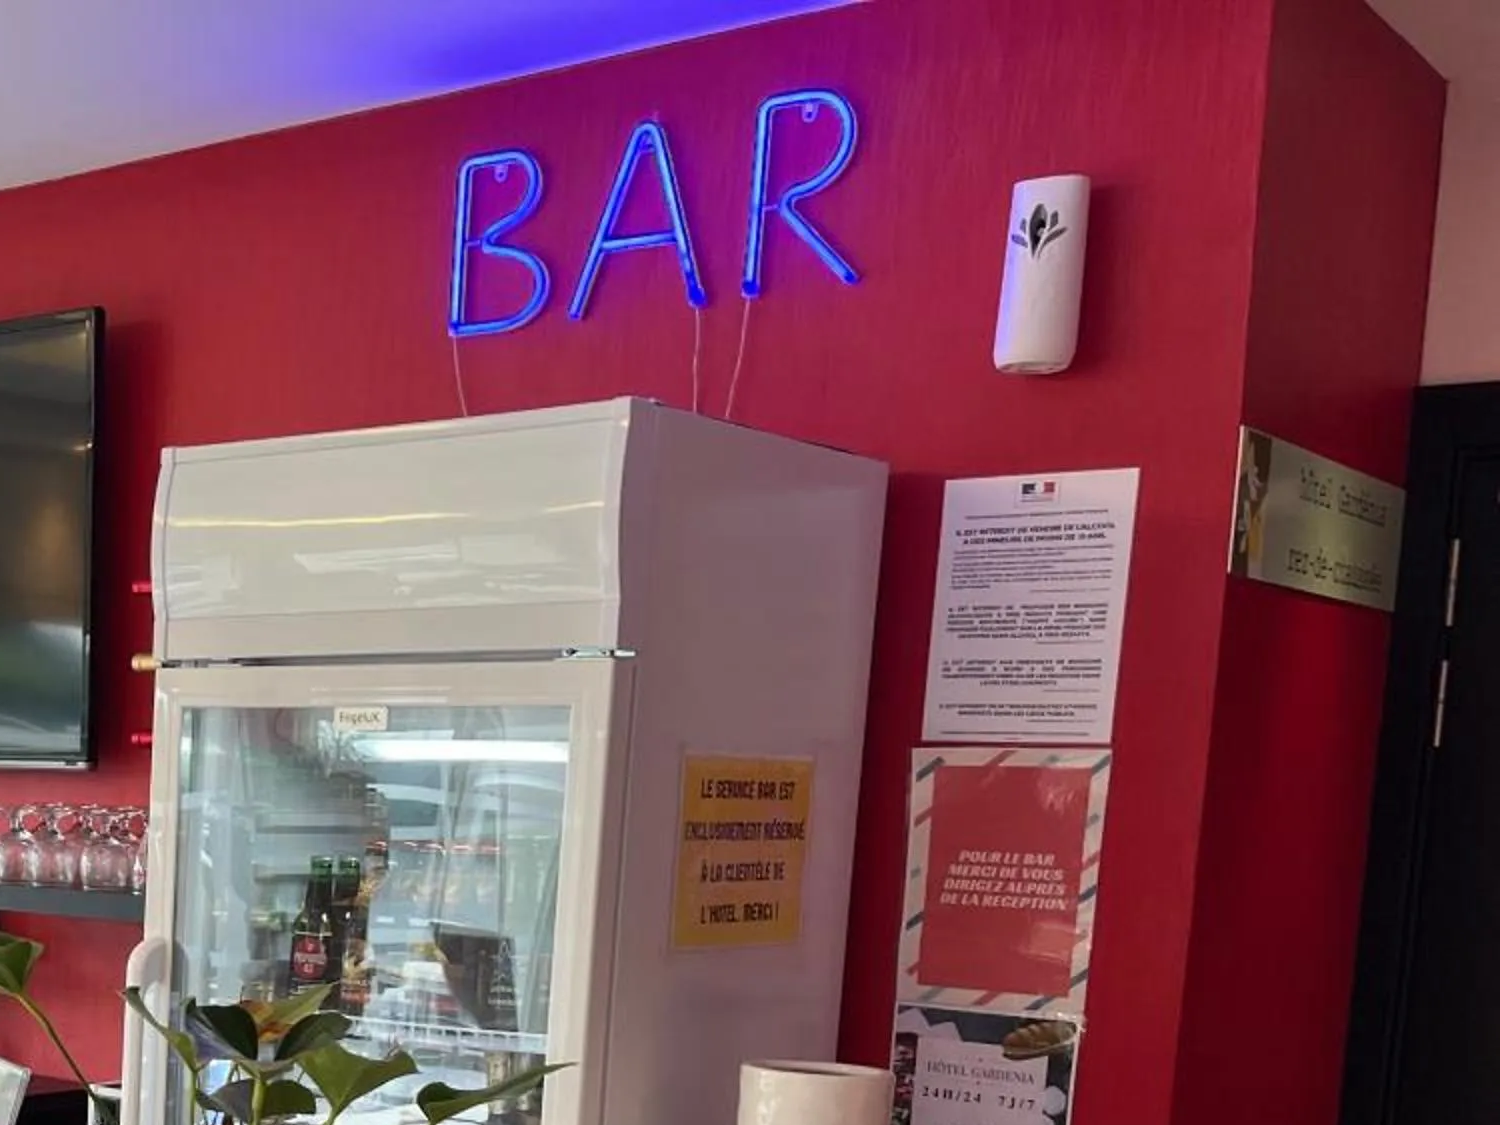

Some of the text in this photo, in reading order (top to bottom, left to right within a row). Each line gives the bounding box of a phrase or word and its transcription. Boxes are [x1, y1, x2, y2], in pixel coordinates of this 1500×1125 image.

[448, 87, 862, 338] BAR
[701, 779, 712, 799] LE
[779, 781, 796, 801] EST
[958, 851, 1001, 863] POUR
[1003, 851, 1021, 864] LE
[948, 863, 1065, 881] MERCI DE VOUS
[940, 892, 959, 905] DE
[927, 1060, 1035, 1084] HÔTEL GARDENIA
